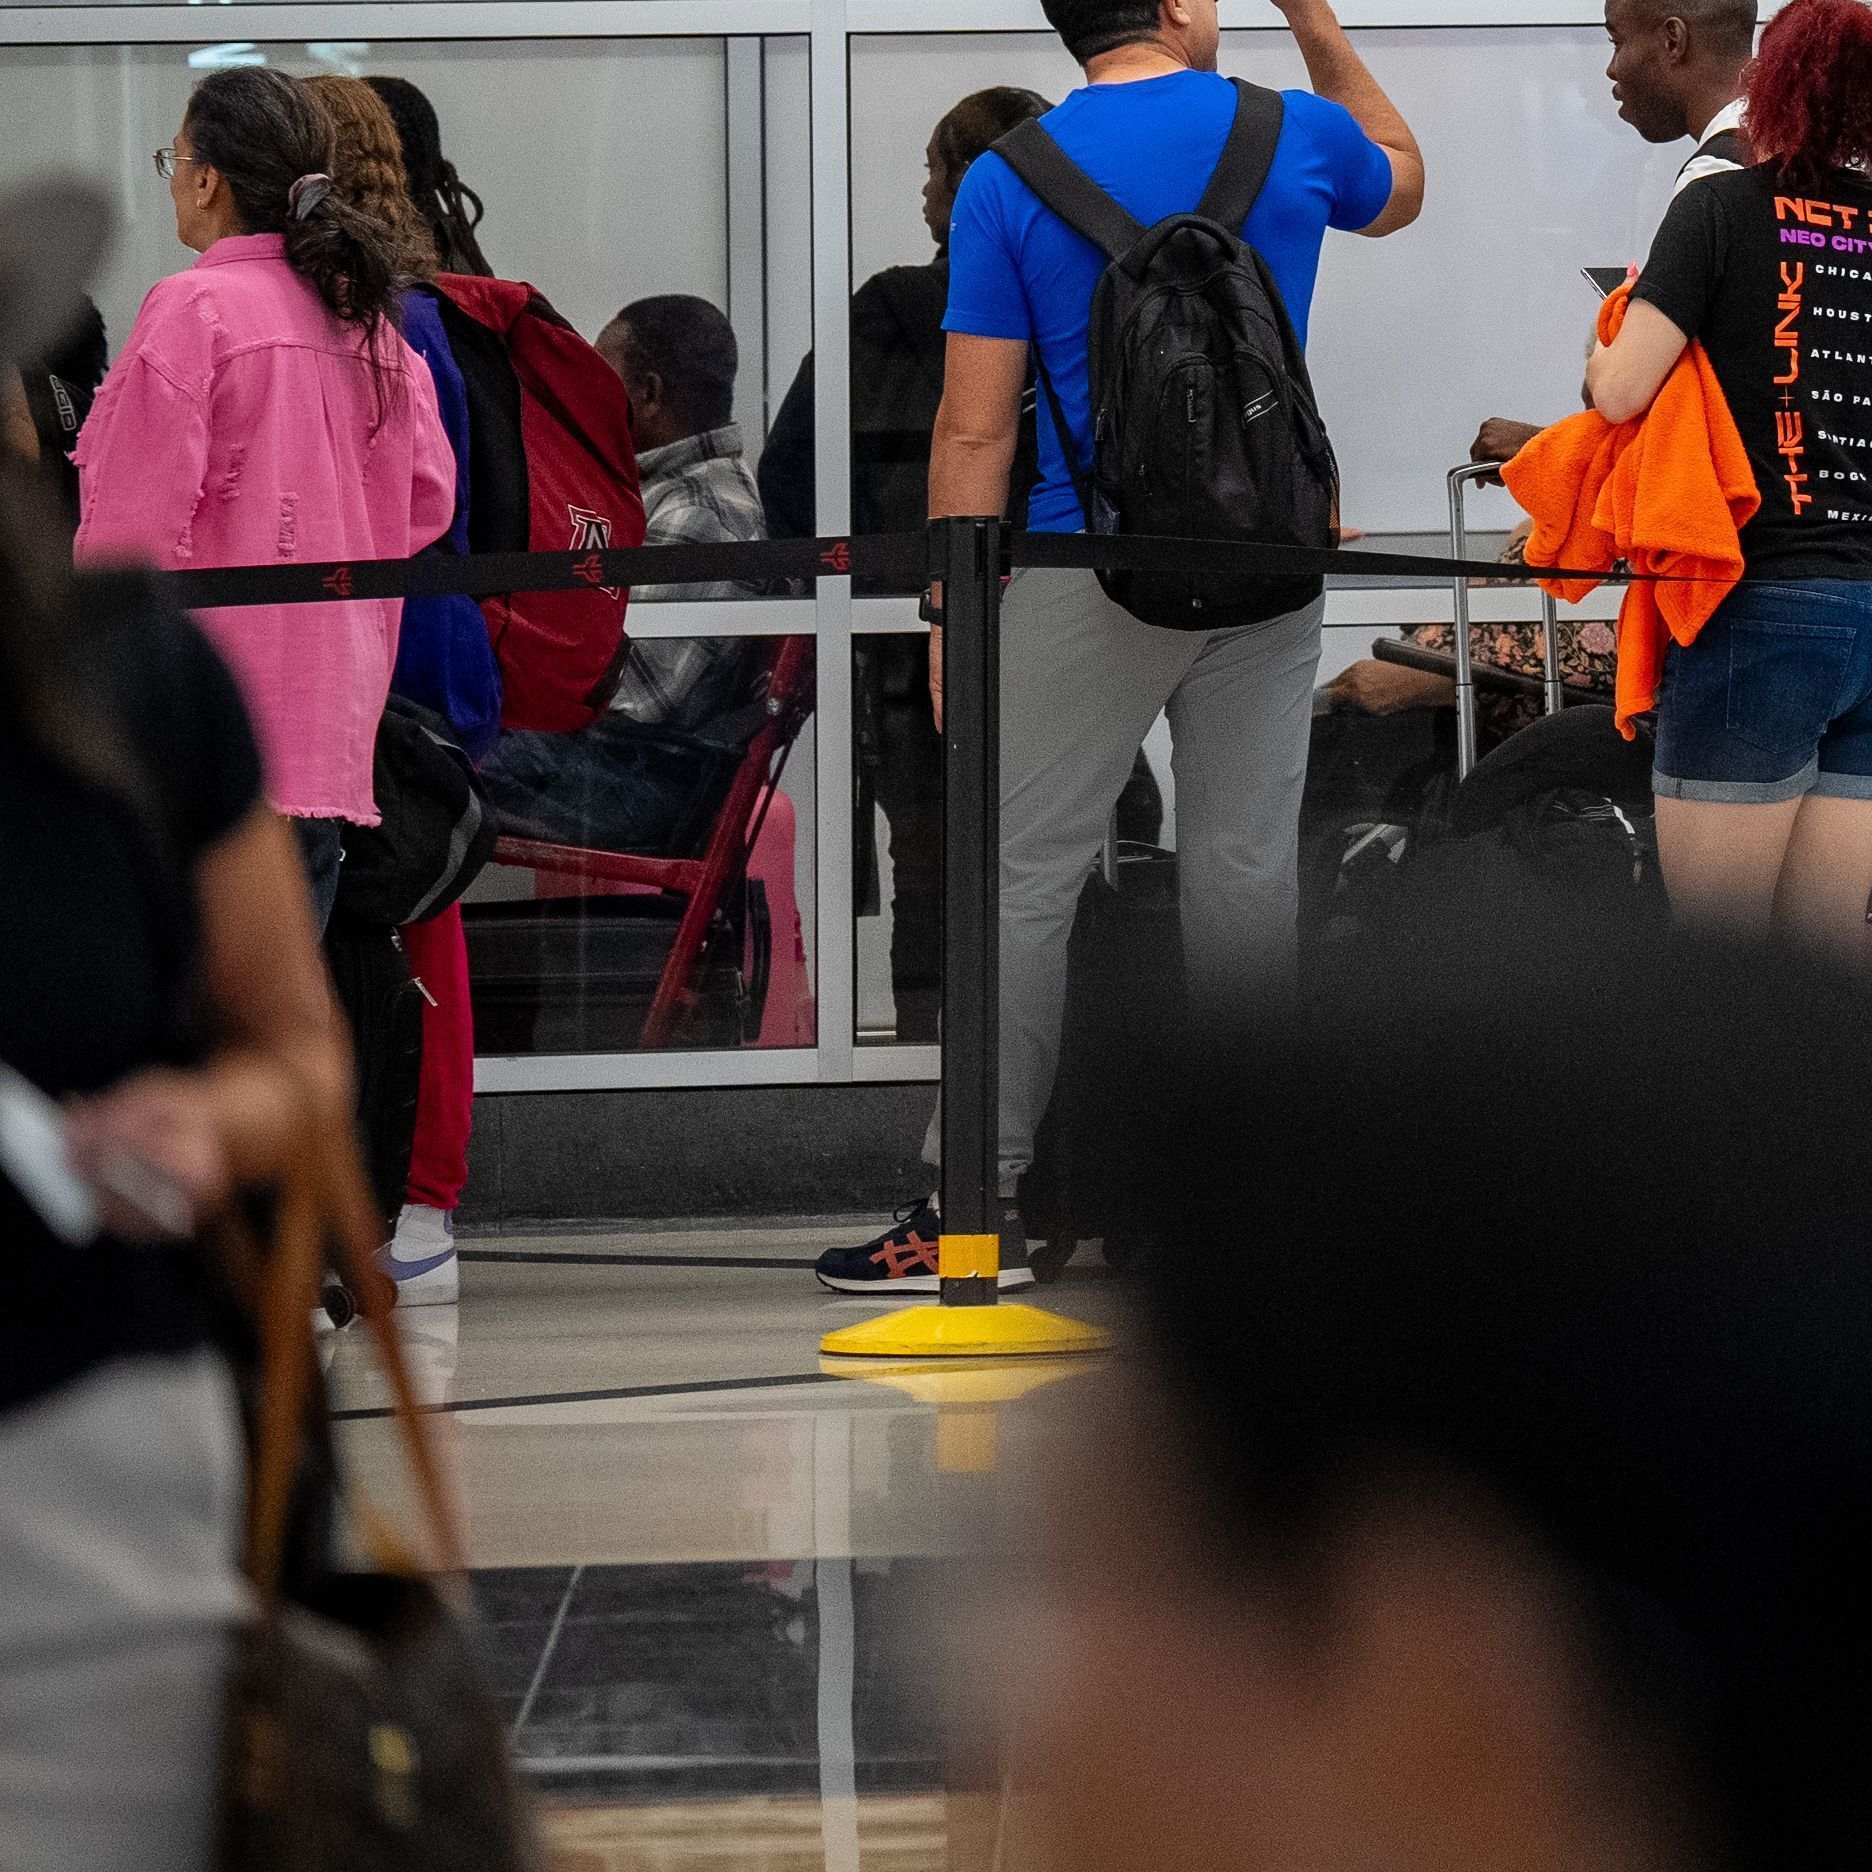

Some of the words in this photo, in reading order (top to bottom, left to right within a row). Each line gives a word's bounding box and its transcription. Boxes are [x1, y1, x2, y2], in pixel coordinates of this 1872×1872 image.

[1773, 196, 1859, 230] NCT
[1779, 228, 1826, 248] NEO
[1811, 389, 1843, 403] SÃO
